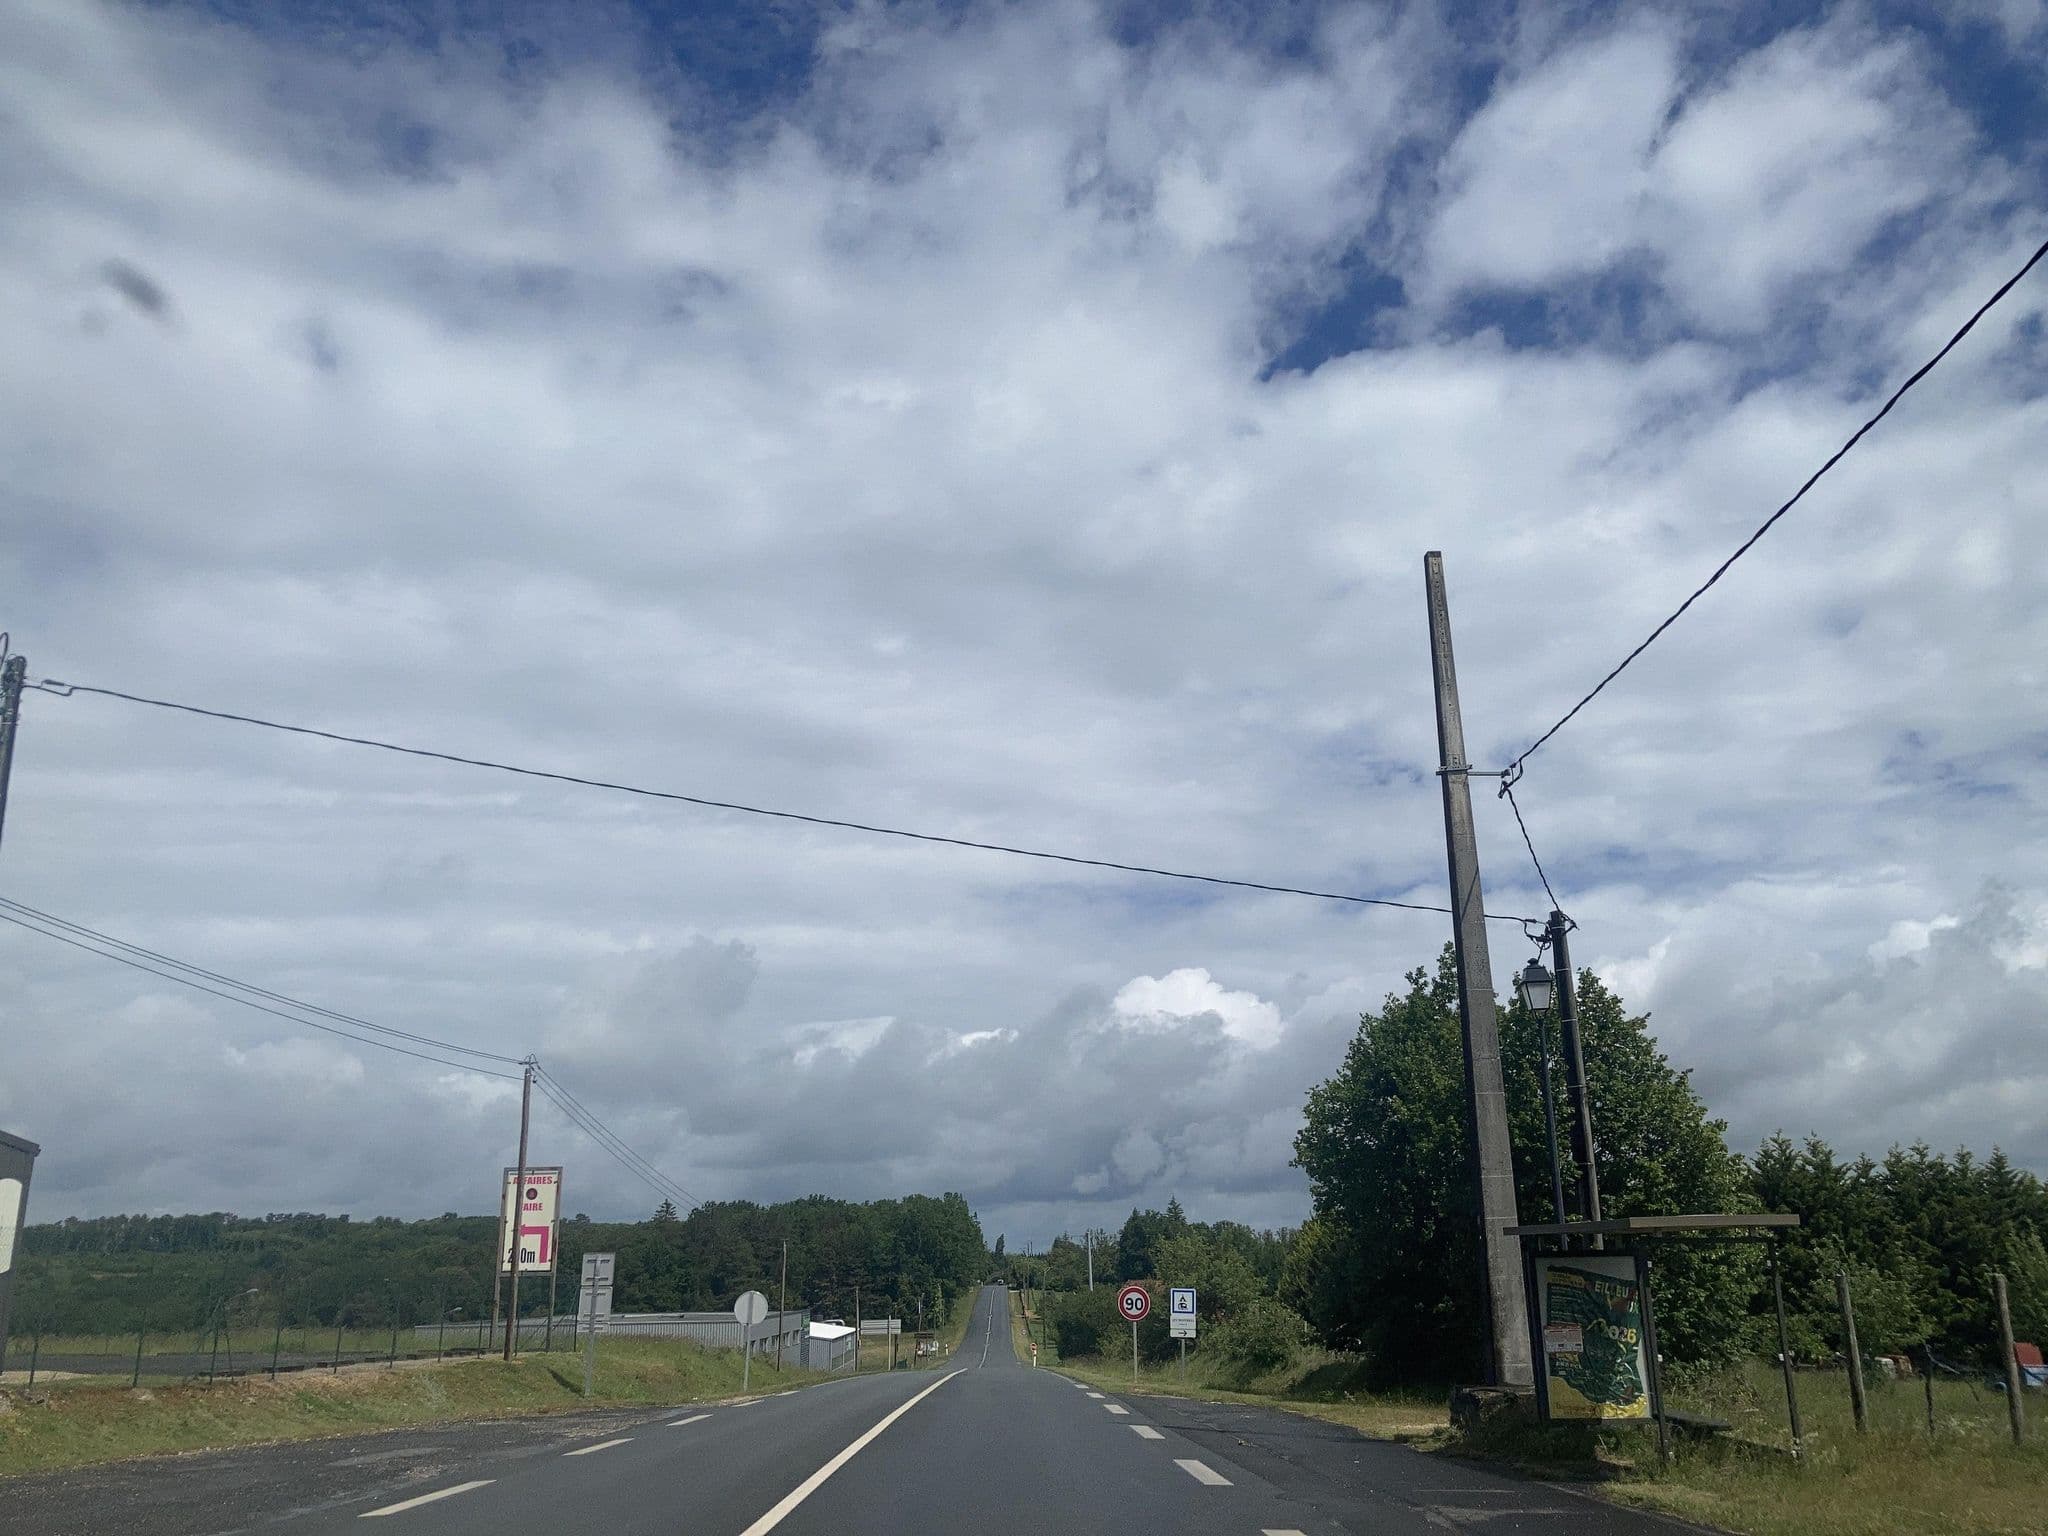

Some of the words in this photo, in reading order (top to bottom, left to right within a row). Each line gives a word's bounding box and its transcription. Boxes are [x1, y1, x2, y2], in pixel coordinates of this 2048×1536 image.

[513, 1176, 553, 1185] AFAIRES
[507, 1248, 535, 1264] 20m
[1125, 1297, 1144, 1311] 90
